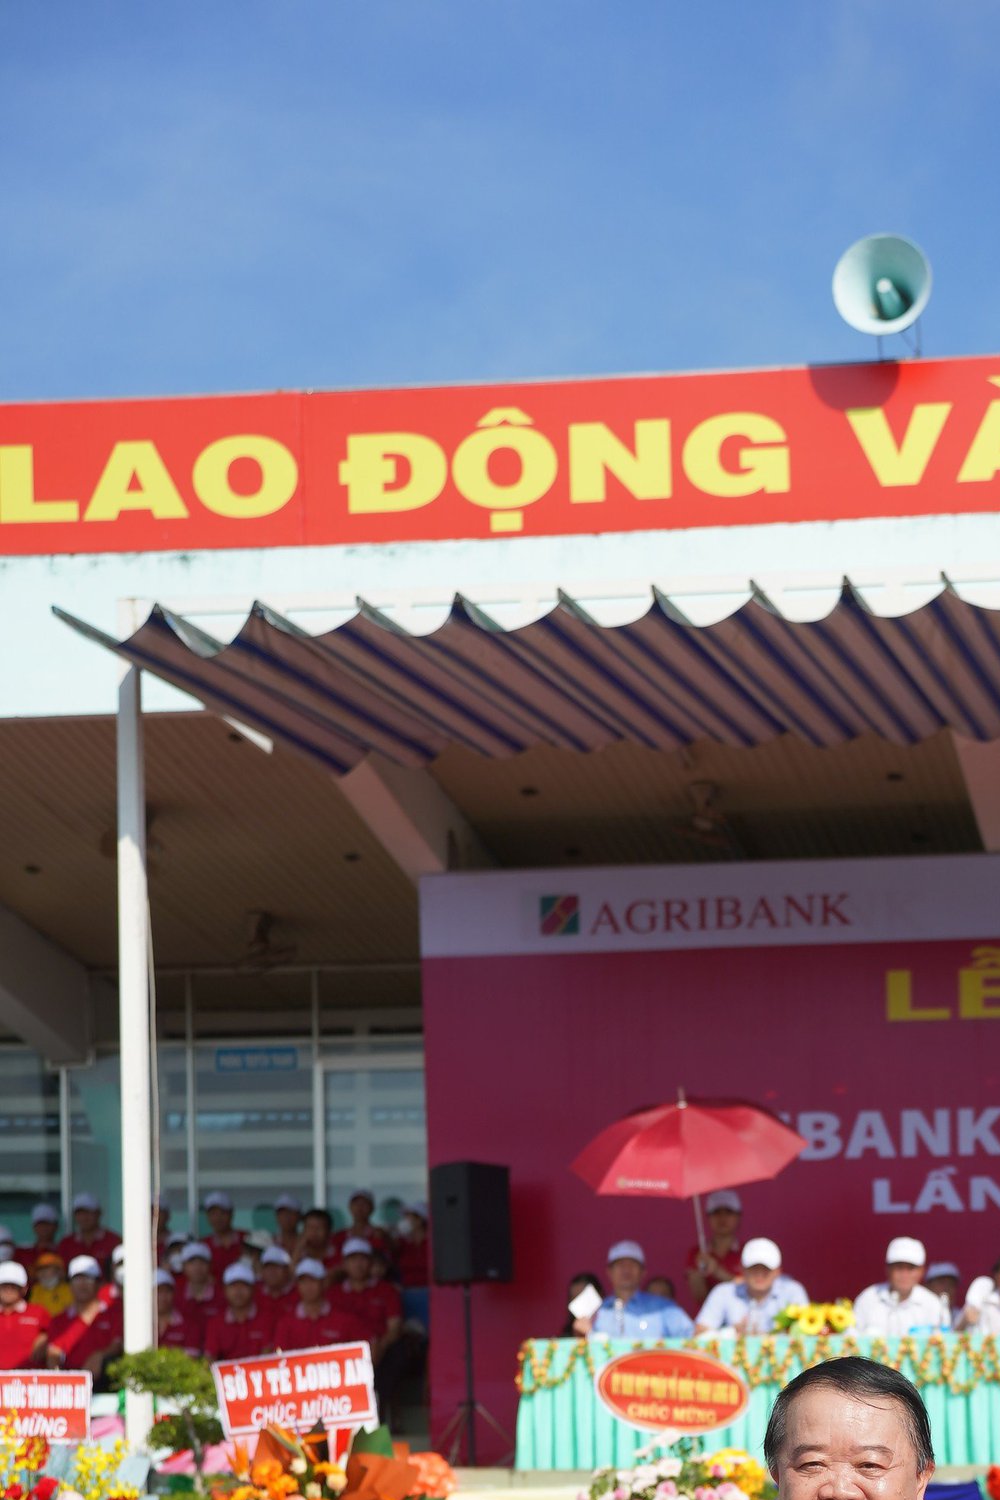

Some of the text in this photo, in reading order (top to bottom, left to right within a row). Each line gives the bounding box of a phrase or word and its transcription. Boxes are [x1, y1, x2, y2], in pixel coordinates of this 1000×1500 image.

[0, 436, 298, 523] LAO
[339, 407, 791, 532] ĐỘNG
[591, 893, 852, 935] AGRIBANK
[250, 1370, 263, 1398] Y
[294, 1360, 341, 1393] LONG
[344, 1358, 371, 1387] AN
